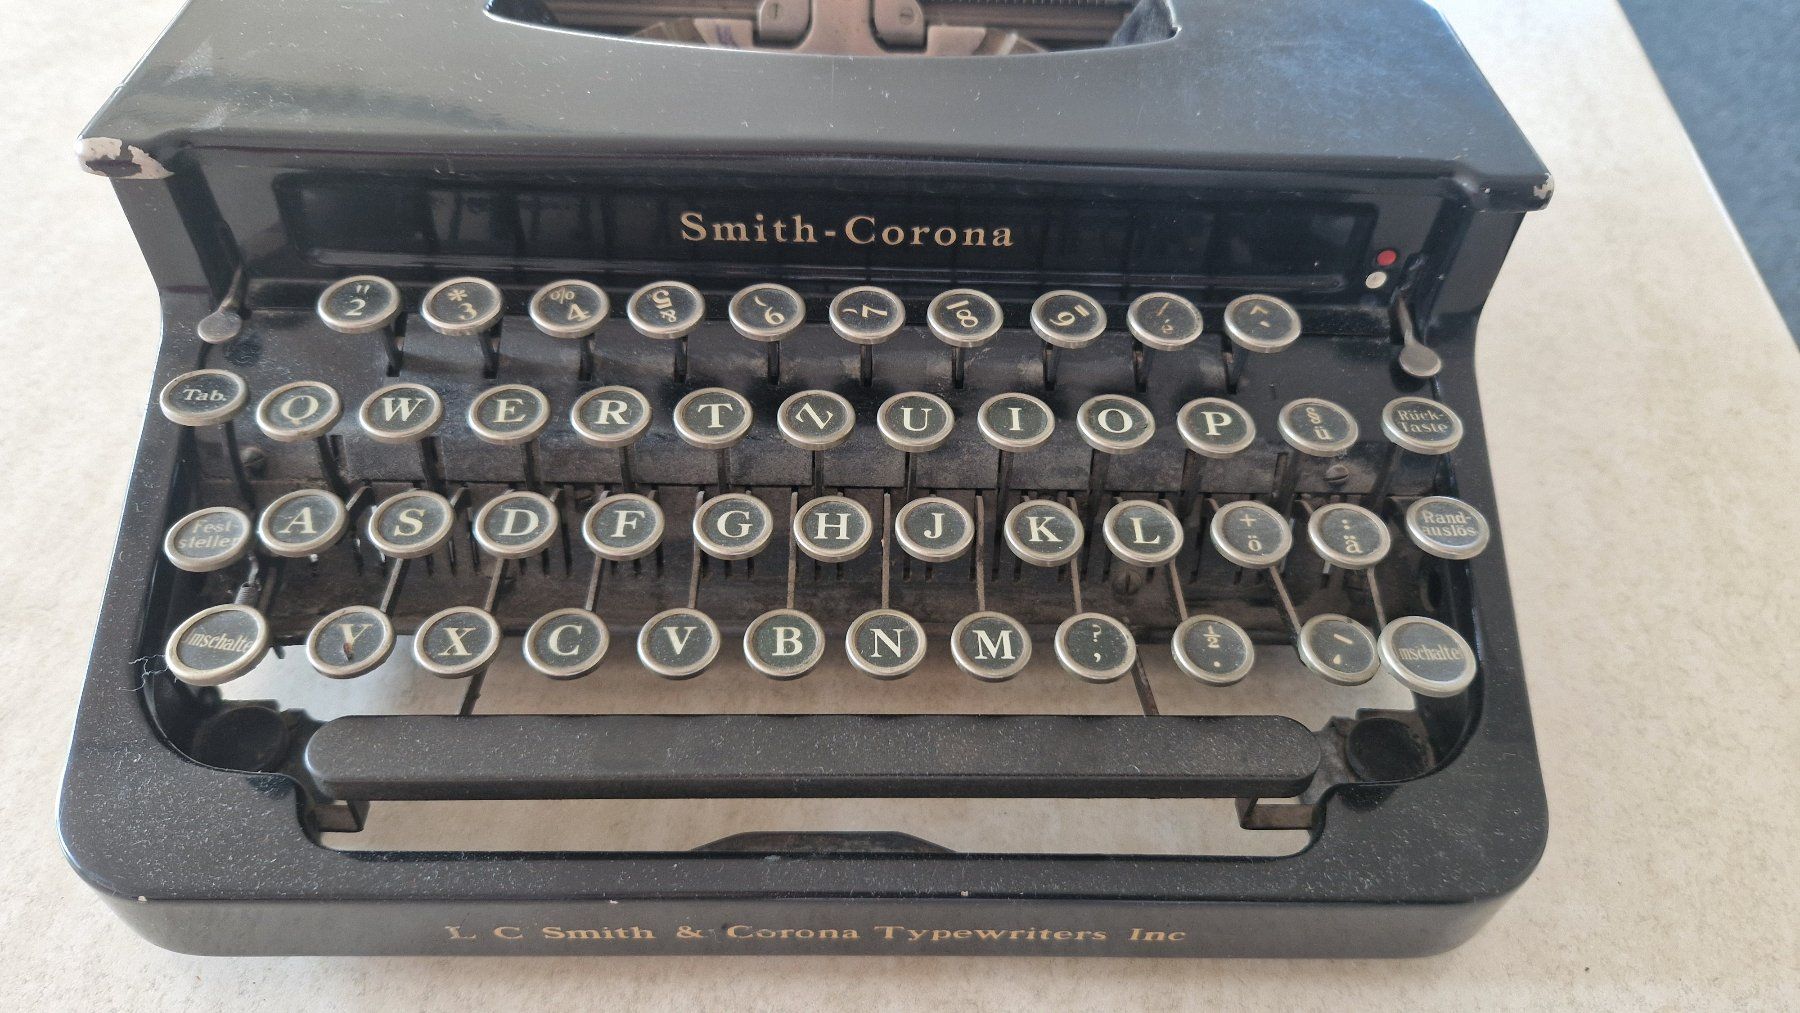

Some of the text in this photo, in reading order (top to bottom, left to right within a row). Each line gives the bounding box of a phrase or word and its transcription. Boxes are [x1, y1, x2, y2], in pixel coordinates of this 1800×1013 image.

[680, 211, 1015, 247] Smith-Corona
[345, 300, 367, 316] 2
[459, 303, 477, 320] 3
[652, 289, 673, 309] 5
[862, 304, 888, 318] 7
[566, 303, 592, 322] 4
[956, 309, 979, 328] 8
[182, 388, 228, 401] Tab.
[280, 395, 319, 426] Q
[382, 397, 426, 422] W
[494, 398, 526, 423] E
[594, 399, 630, 425] R
[698, 403, 733, 428] T
[795, 402, 833, 430] Z
[901, 407, 933, 431] U
[1008, 407, 1023, 431] I
[1098, 408, 1133, 433] O
[1201, 411, 1232, 436] P
[1313, 426, 1333, 441] ü
[1398, 421, 1448, 433] Taste
[279, 506, 317, 534] A
[394, 508, 426, 536] S
[498, 508, 540, 537] D
[610, 510, 645, 538] F
[717, 510, 754, 538] G
[814, 512, 851, 540] H
[923, 512, 946, 539] J
[1026, 516, 1063, 542] K
[1421, 510, 1472, 524] Rand-
[1129, 517, 1160, 544] L
[1422, 525, 1478, 537] auslös
[1247, 535, 1262, 552] ö
[1343, 535, 1363, 554] ä
[339, 623, 373, 651] Y
[437, 627, 475, 656] X
[548, 625, 583, 656] C
[663, 626, 697, 655] V
[771, 626, 803, 656] B
[870, 628, 902, 657] N
[972, 629, 1016, 660] M
[445, 925, 1187, 942] L C Smith & Corona Typewriters Inc
